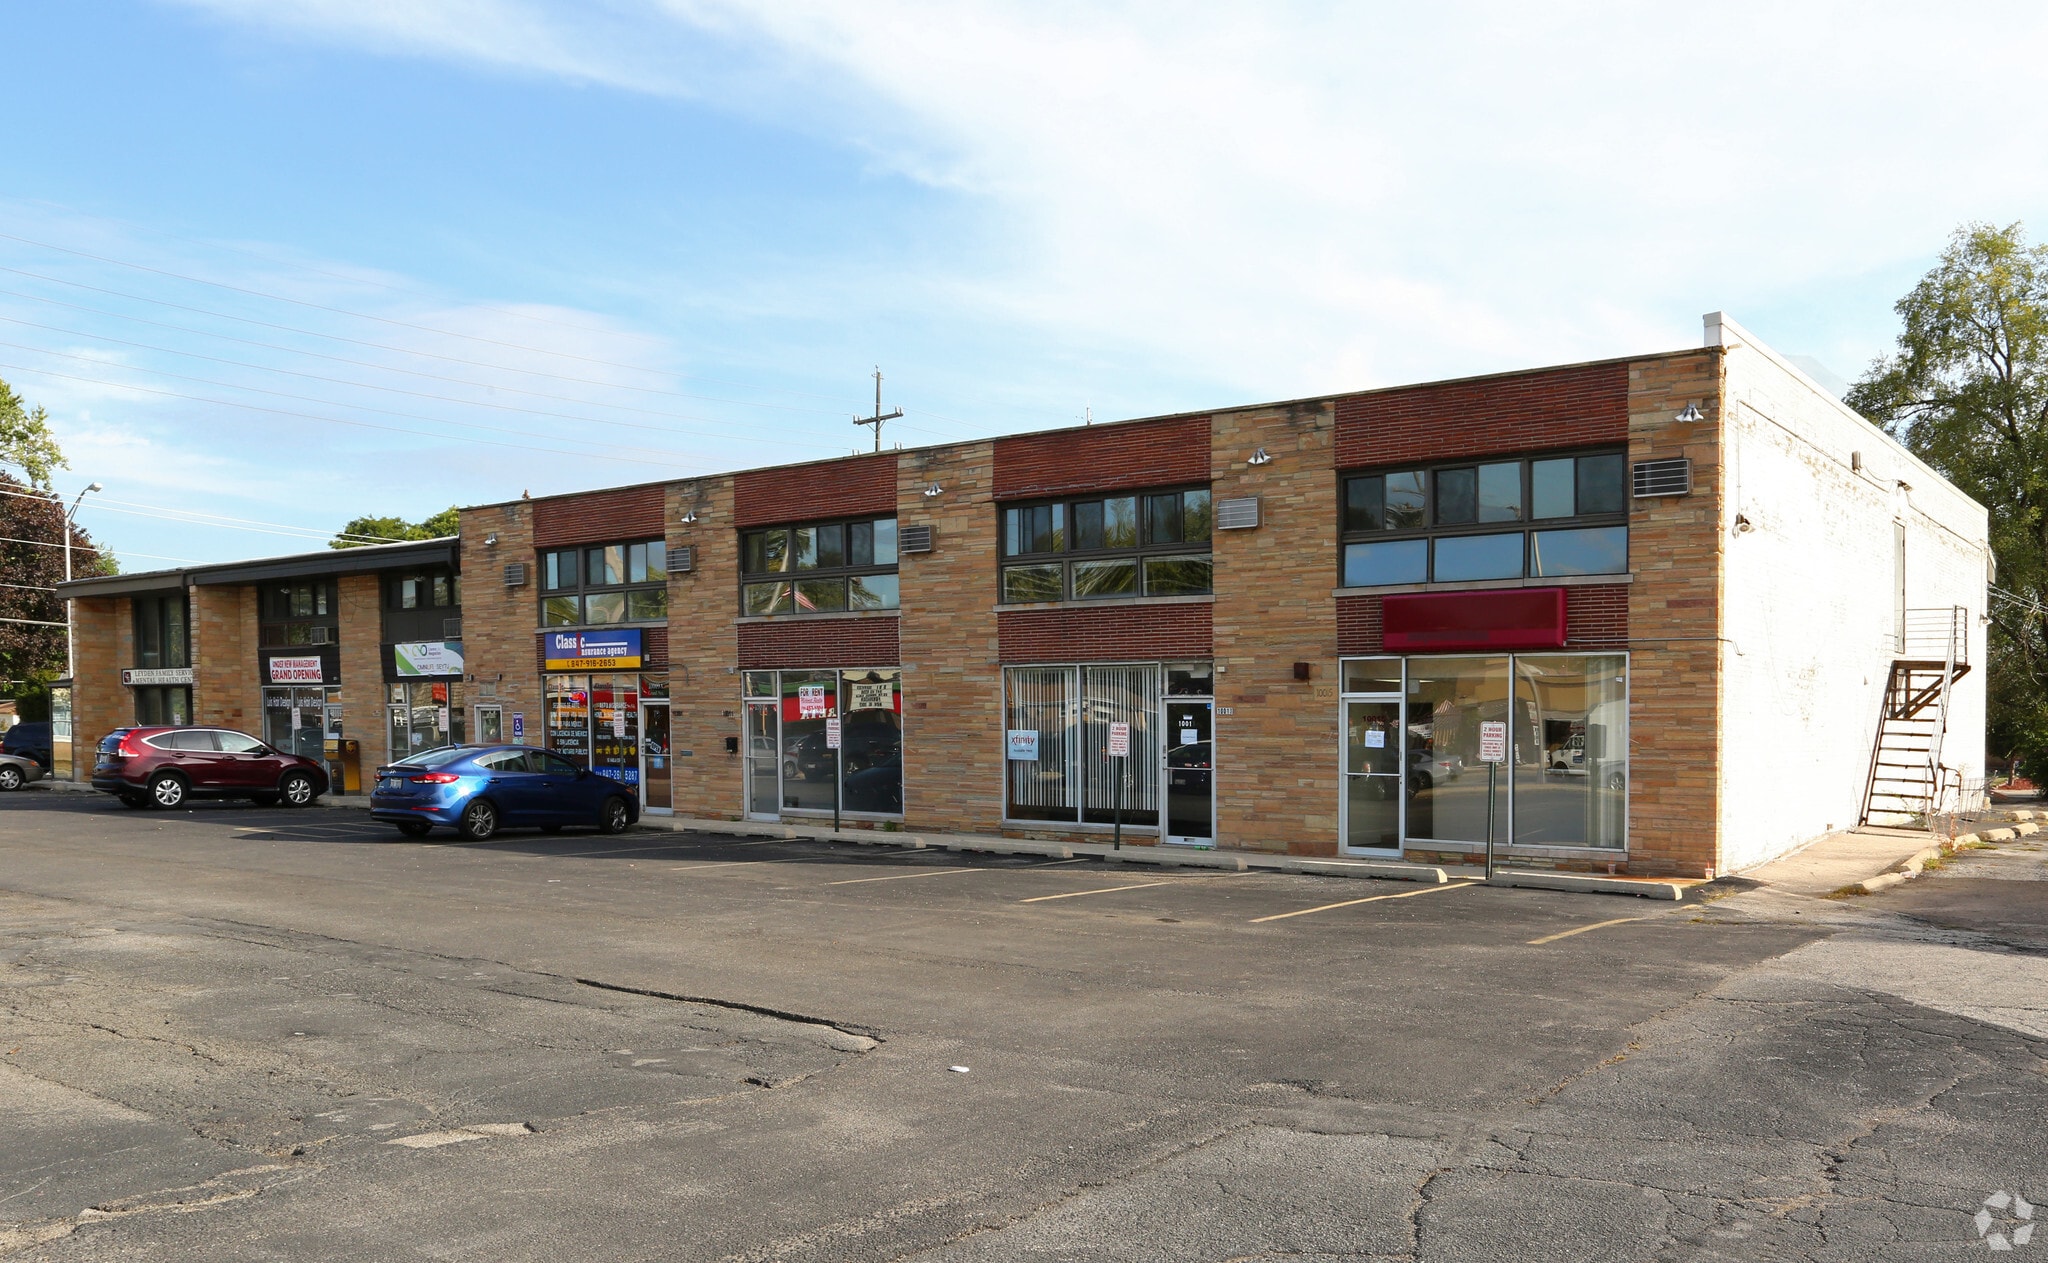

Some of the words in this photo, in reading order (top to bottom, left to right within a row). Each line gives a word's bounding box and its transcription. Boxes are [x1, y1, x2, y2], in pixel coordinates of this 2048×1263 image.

[272, 660, 284, 668] UNDER
[284, 660, 292, 668] NEW
[293, 660, 318, 668] MANAGEMENT
[271, 669, 292, 680] GRAND
[293, 669, 322, 680] OPENING
[800, 688, 809, 697] FOR
[811, 688, 823, 697] RENT
[280, 696, 291, 709] Design
[310, 696, 322, 709] Design
[1011, 734, 1035, 746] xfinity
[602, 769, 638, 781] 847-265287
